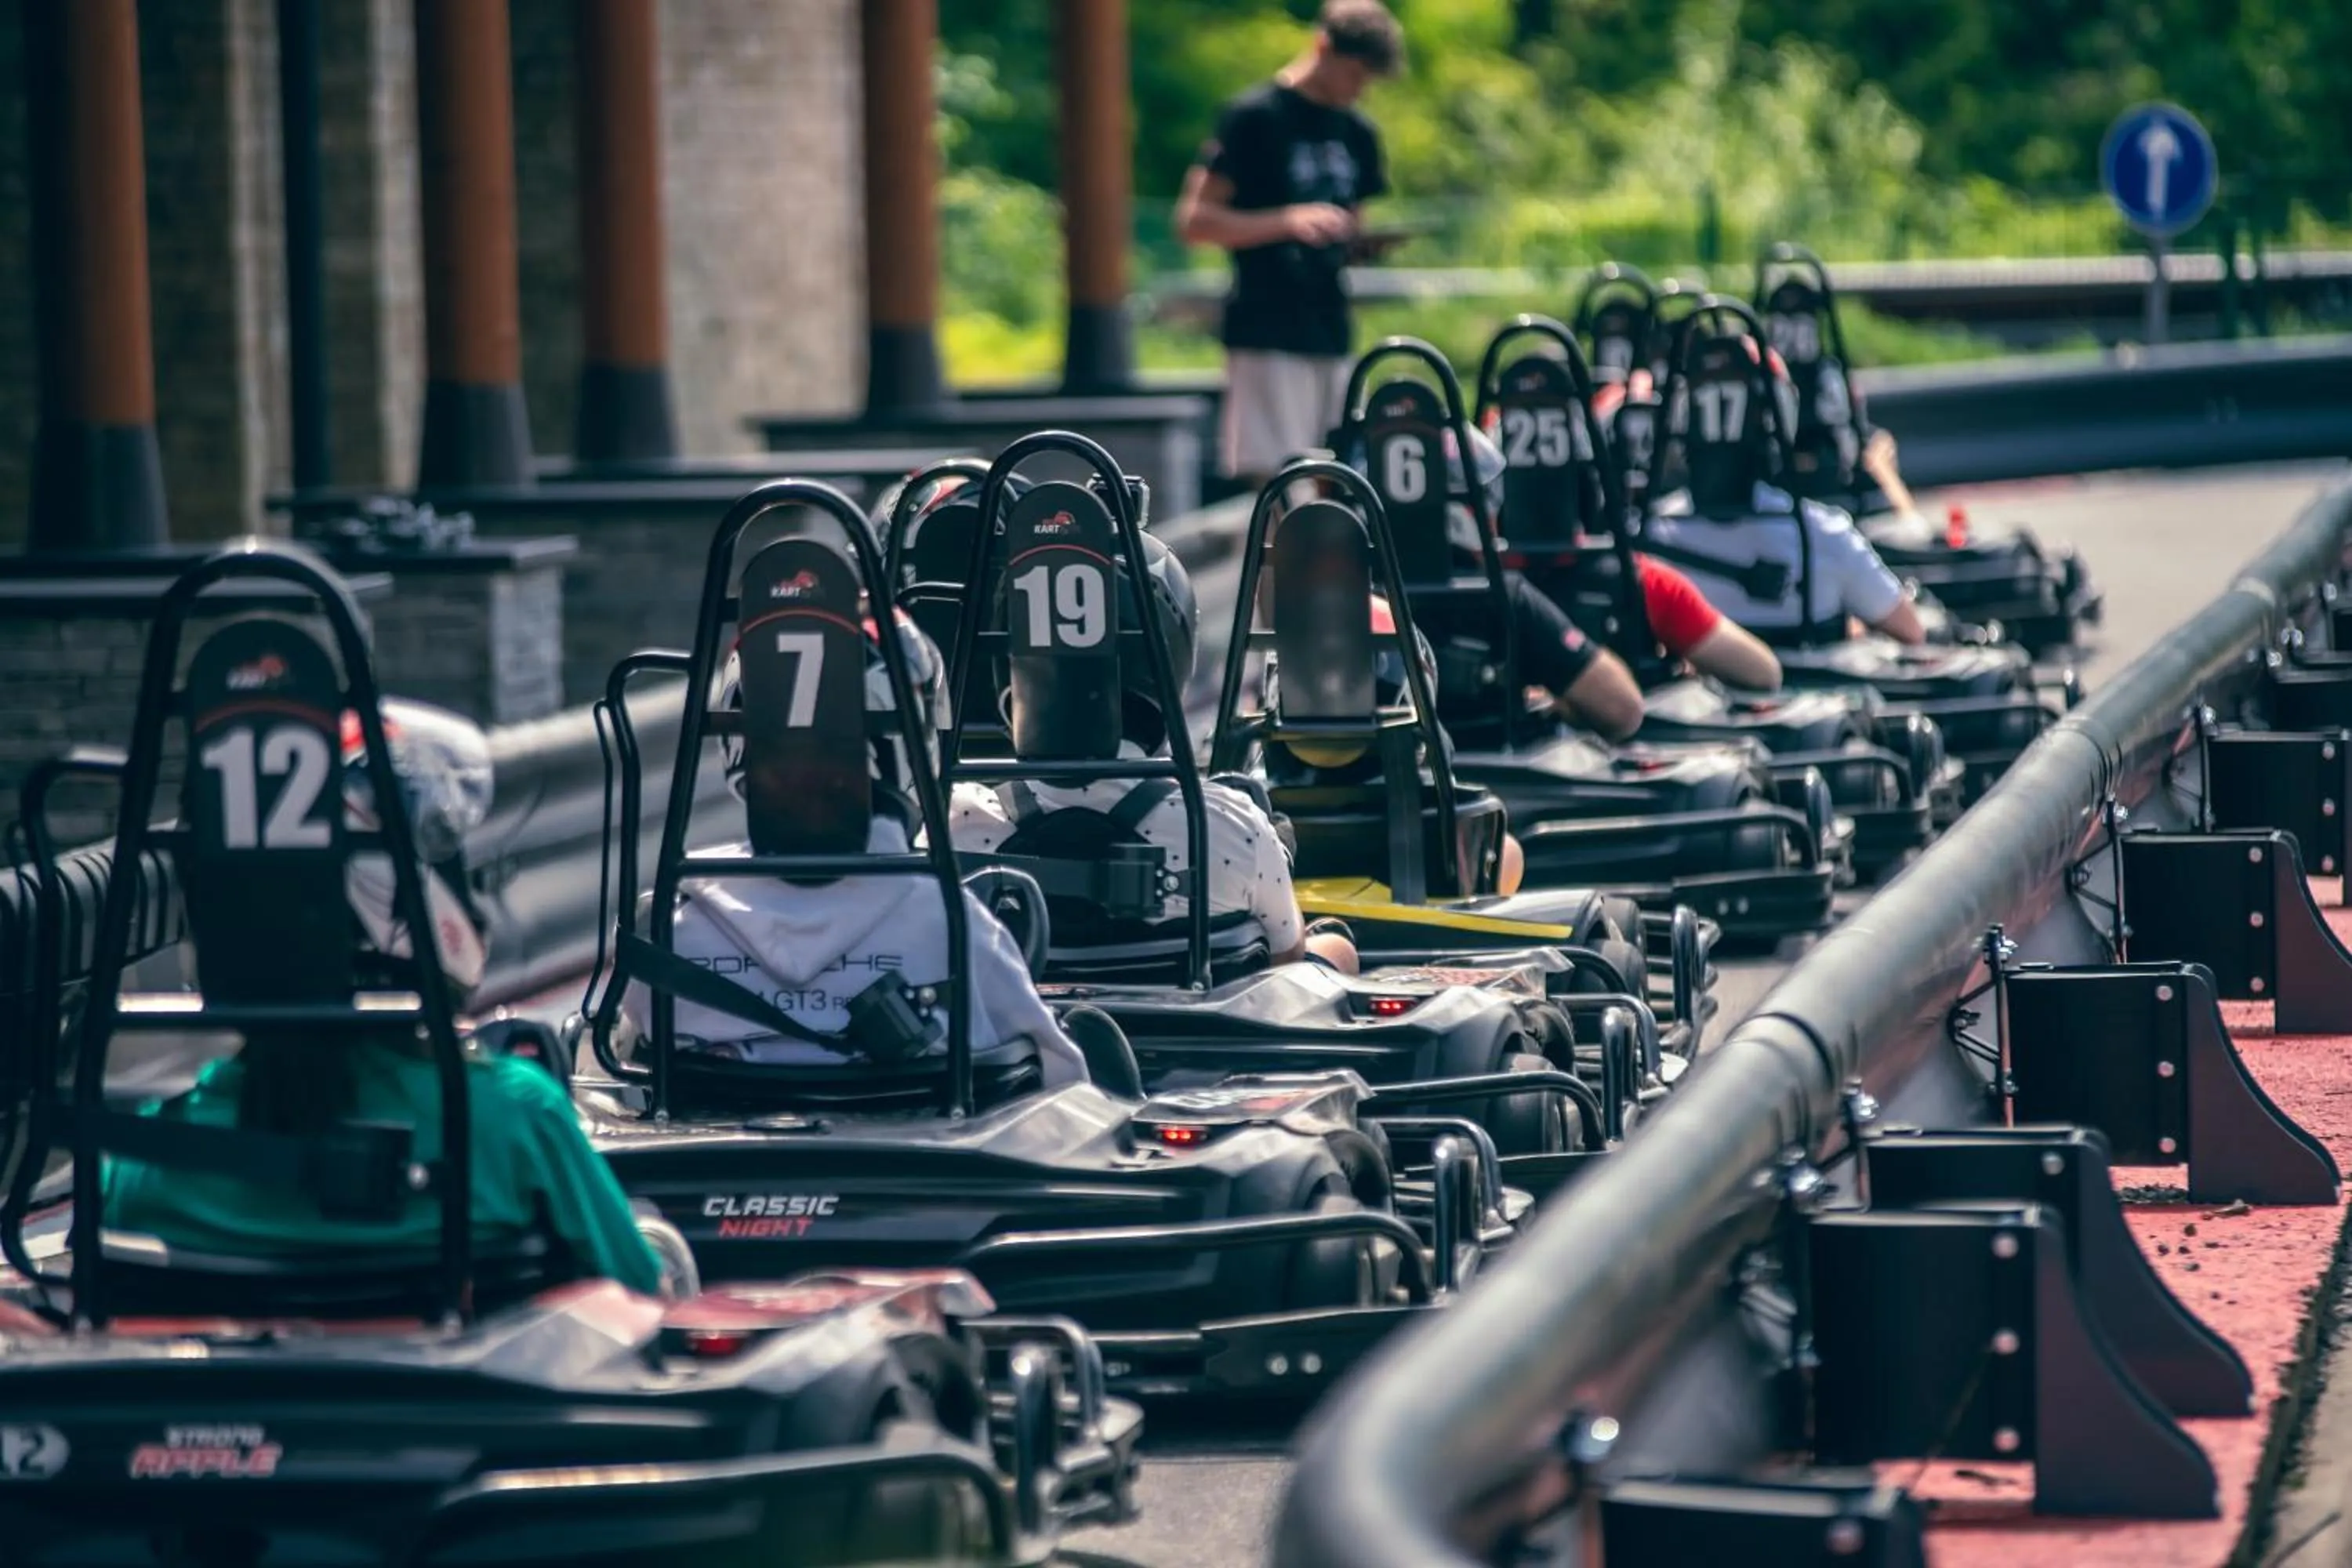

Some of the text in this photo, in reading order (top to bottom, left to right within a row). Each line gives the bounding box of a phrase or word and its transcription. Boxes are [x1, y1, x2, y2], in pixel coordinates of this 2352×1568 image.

[1504, 408, 1570, 467] 25
[1693, 380, 1748, 442] 17
[1384, 434, 1428, 503] 6
[1033, 524, 1060, 533] KART
[1013, 564, 1106, 648] 19
[777, 633, 824, 728] 7
[201, 724, 332, 849] 12
[774, 989, 826, 1013] GT3
[704, 1196, 840, 1216] CLASSIC
[719, 1218, 812, 1238] NIGHT
